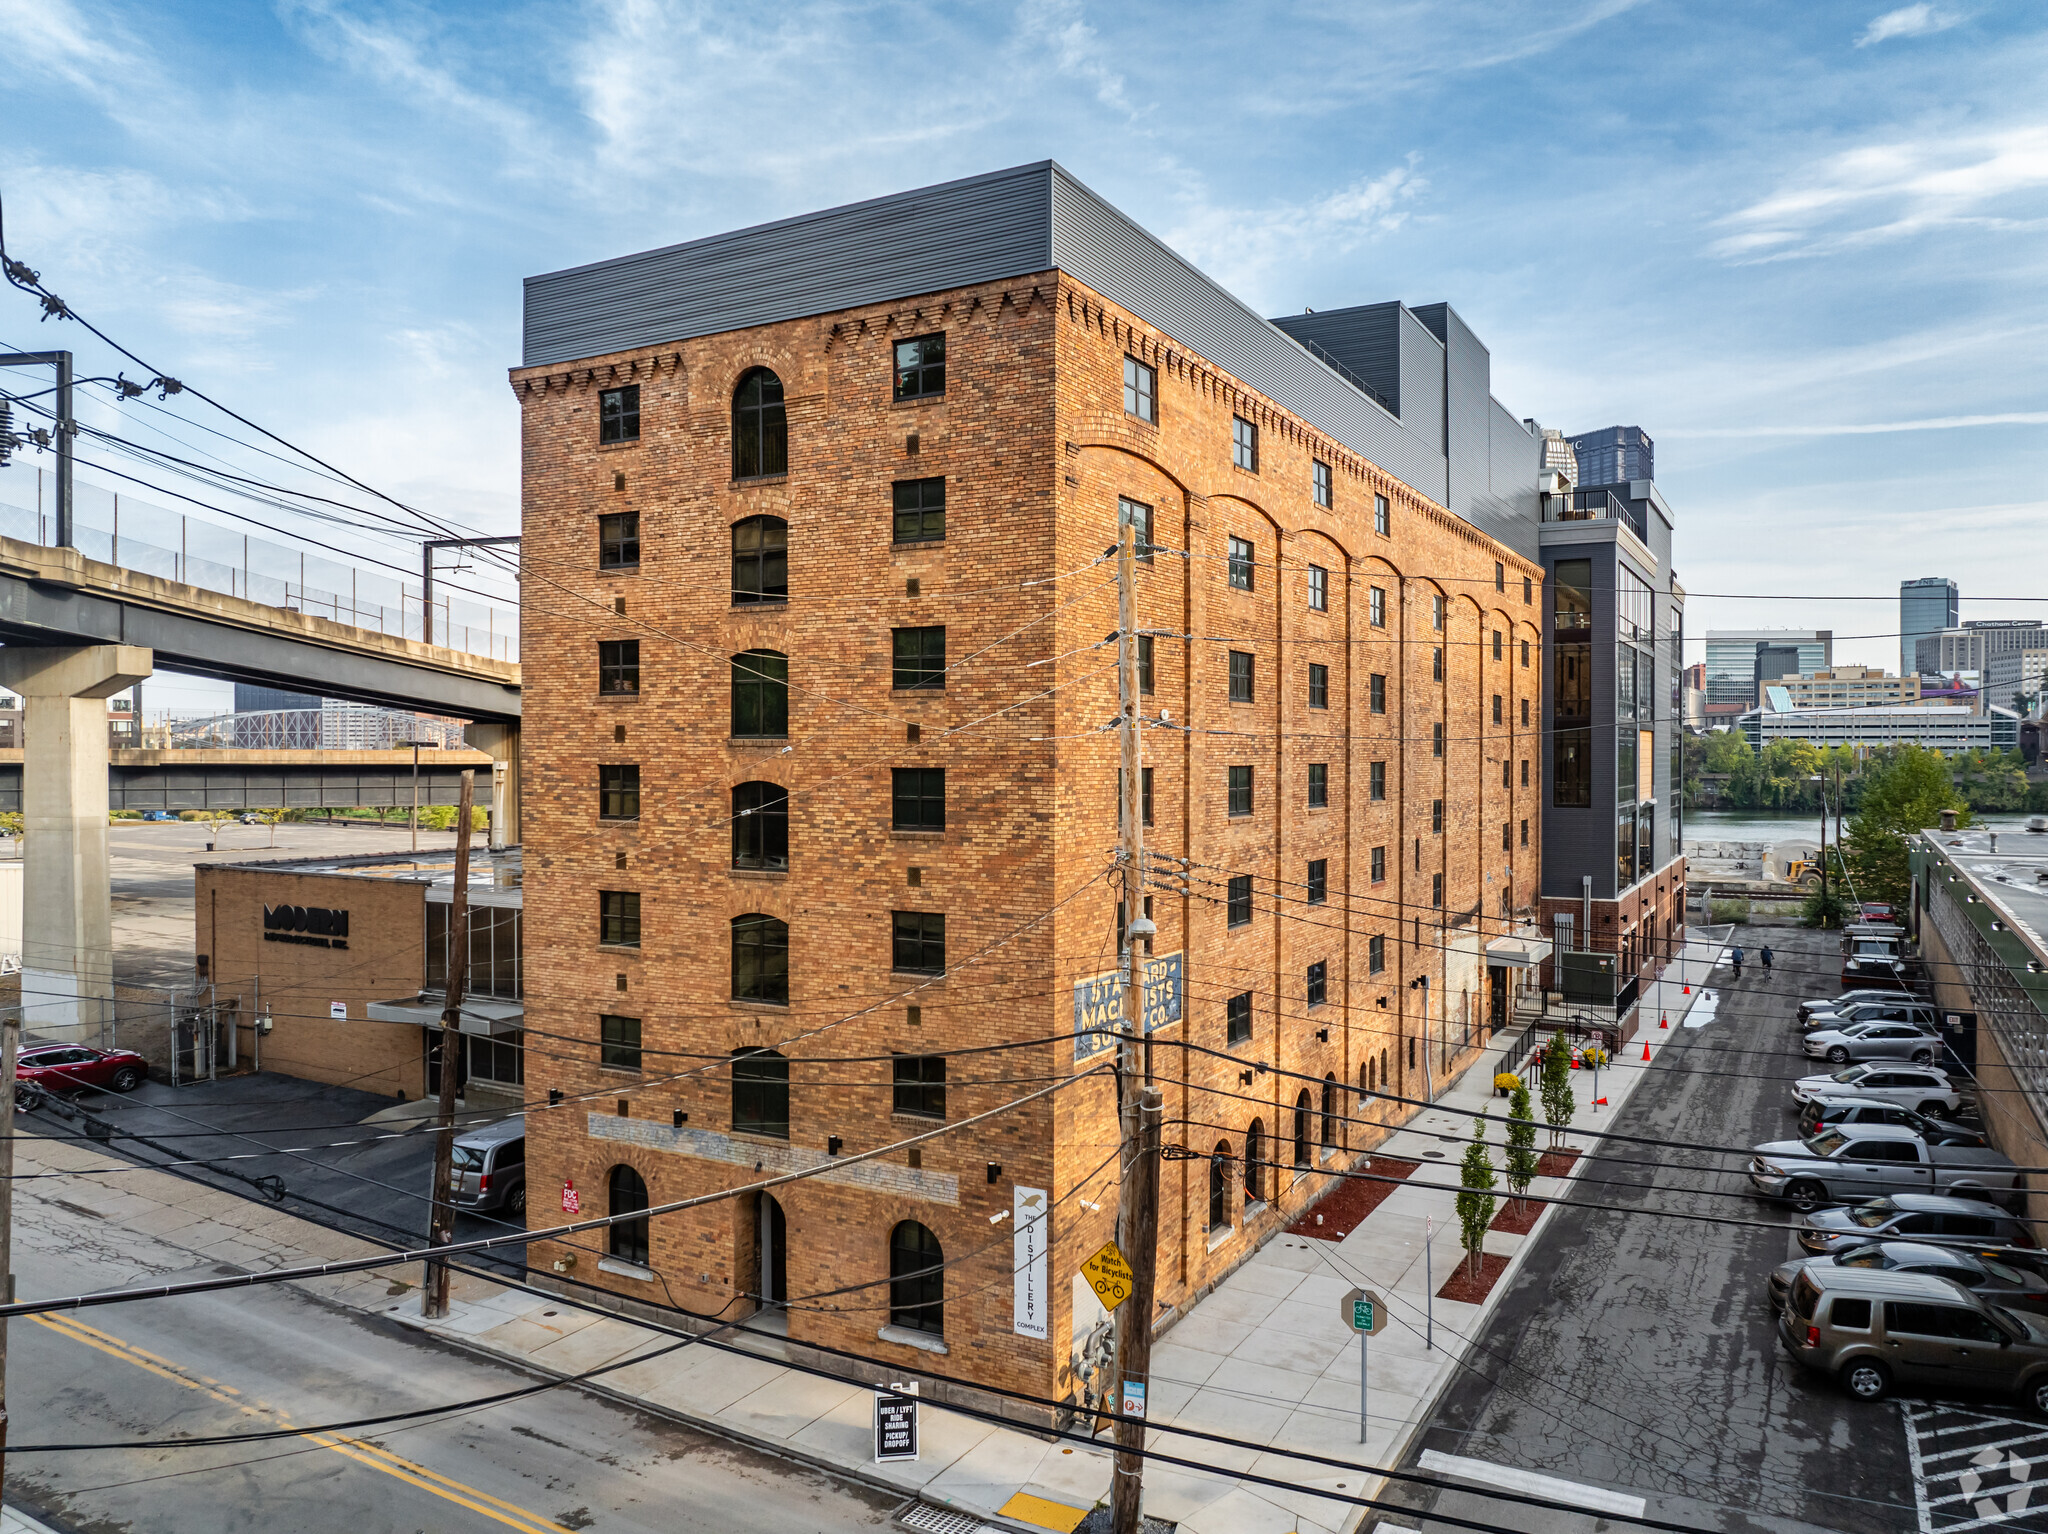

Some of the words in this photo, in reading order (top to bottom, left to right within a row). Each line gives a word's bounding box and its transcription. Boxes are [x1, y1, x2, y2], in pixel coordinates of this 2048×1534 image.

[263, 902, 349, 937] MODERN
[563, 1188, 577, 1199] FDC
[1101, 1254, 1121, 1267] Watch
[1089, 1261, 1099, 1271] for
[1101, 1265, 1133, 1281] Bicyclists
[1016, 1321, 1045, 1333] COMPLEX
[880, 1407, 895, 1415] UBER
[899, 1405, 913, 1414] LYFT
[890, 1414, 904, 1422] RIDE
[884, 1421, 909, 1430] SHARING
[885, 1431, 909, 1440] PICKUP/
[884, 1439, 910, 1449] DROPOFF
